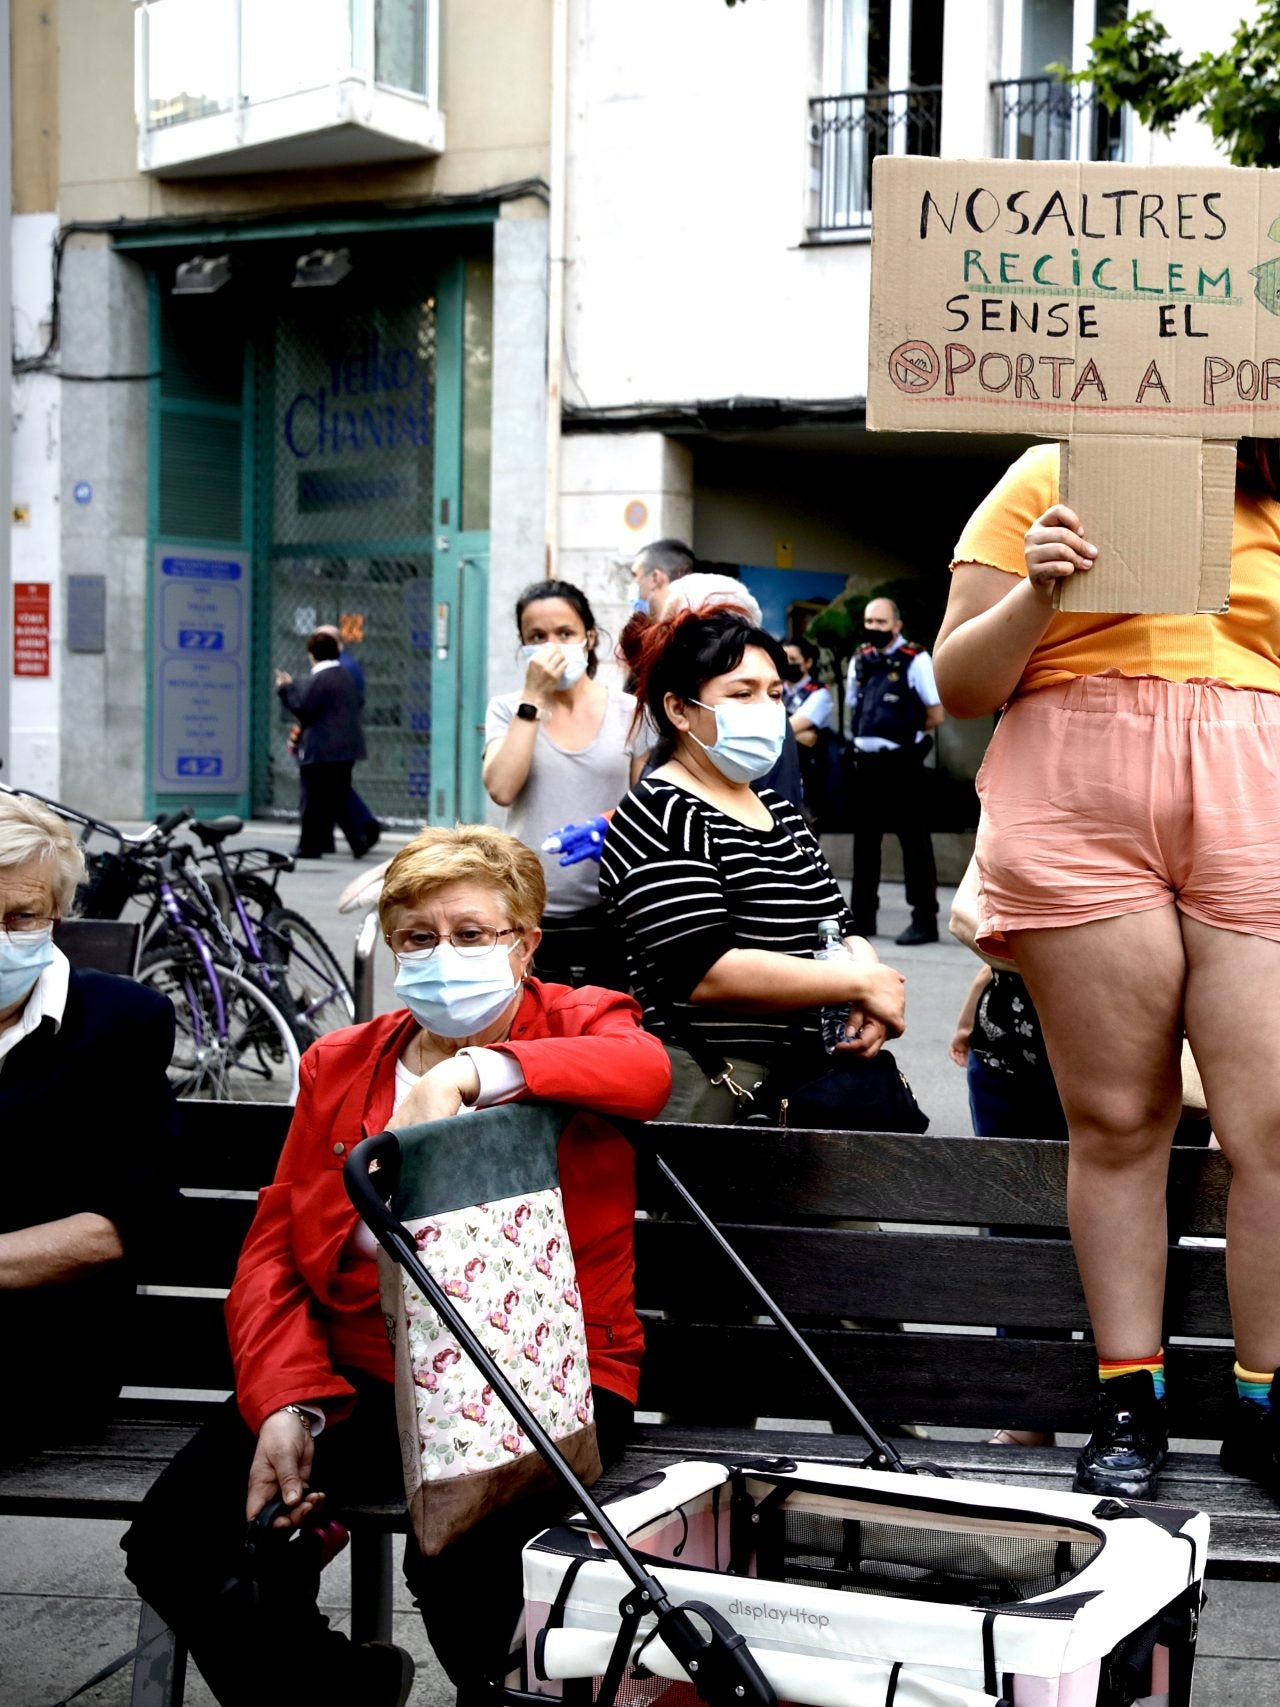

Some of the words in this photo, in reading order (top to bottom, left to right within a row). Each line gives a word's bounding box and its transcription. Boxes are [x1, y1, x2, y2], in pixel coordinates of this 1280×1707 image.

[920, 188, 1227, 240] NOSALTRES
[943, 295, 1099, 339] SENSE
[1159, 304, 1208, 338] EL
[945, 343, 1107, 402] PORTA
[1136, 361, 1171, 404] A
